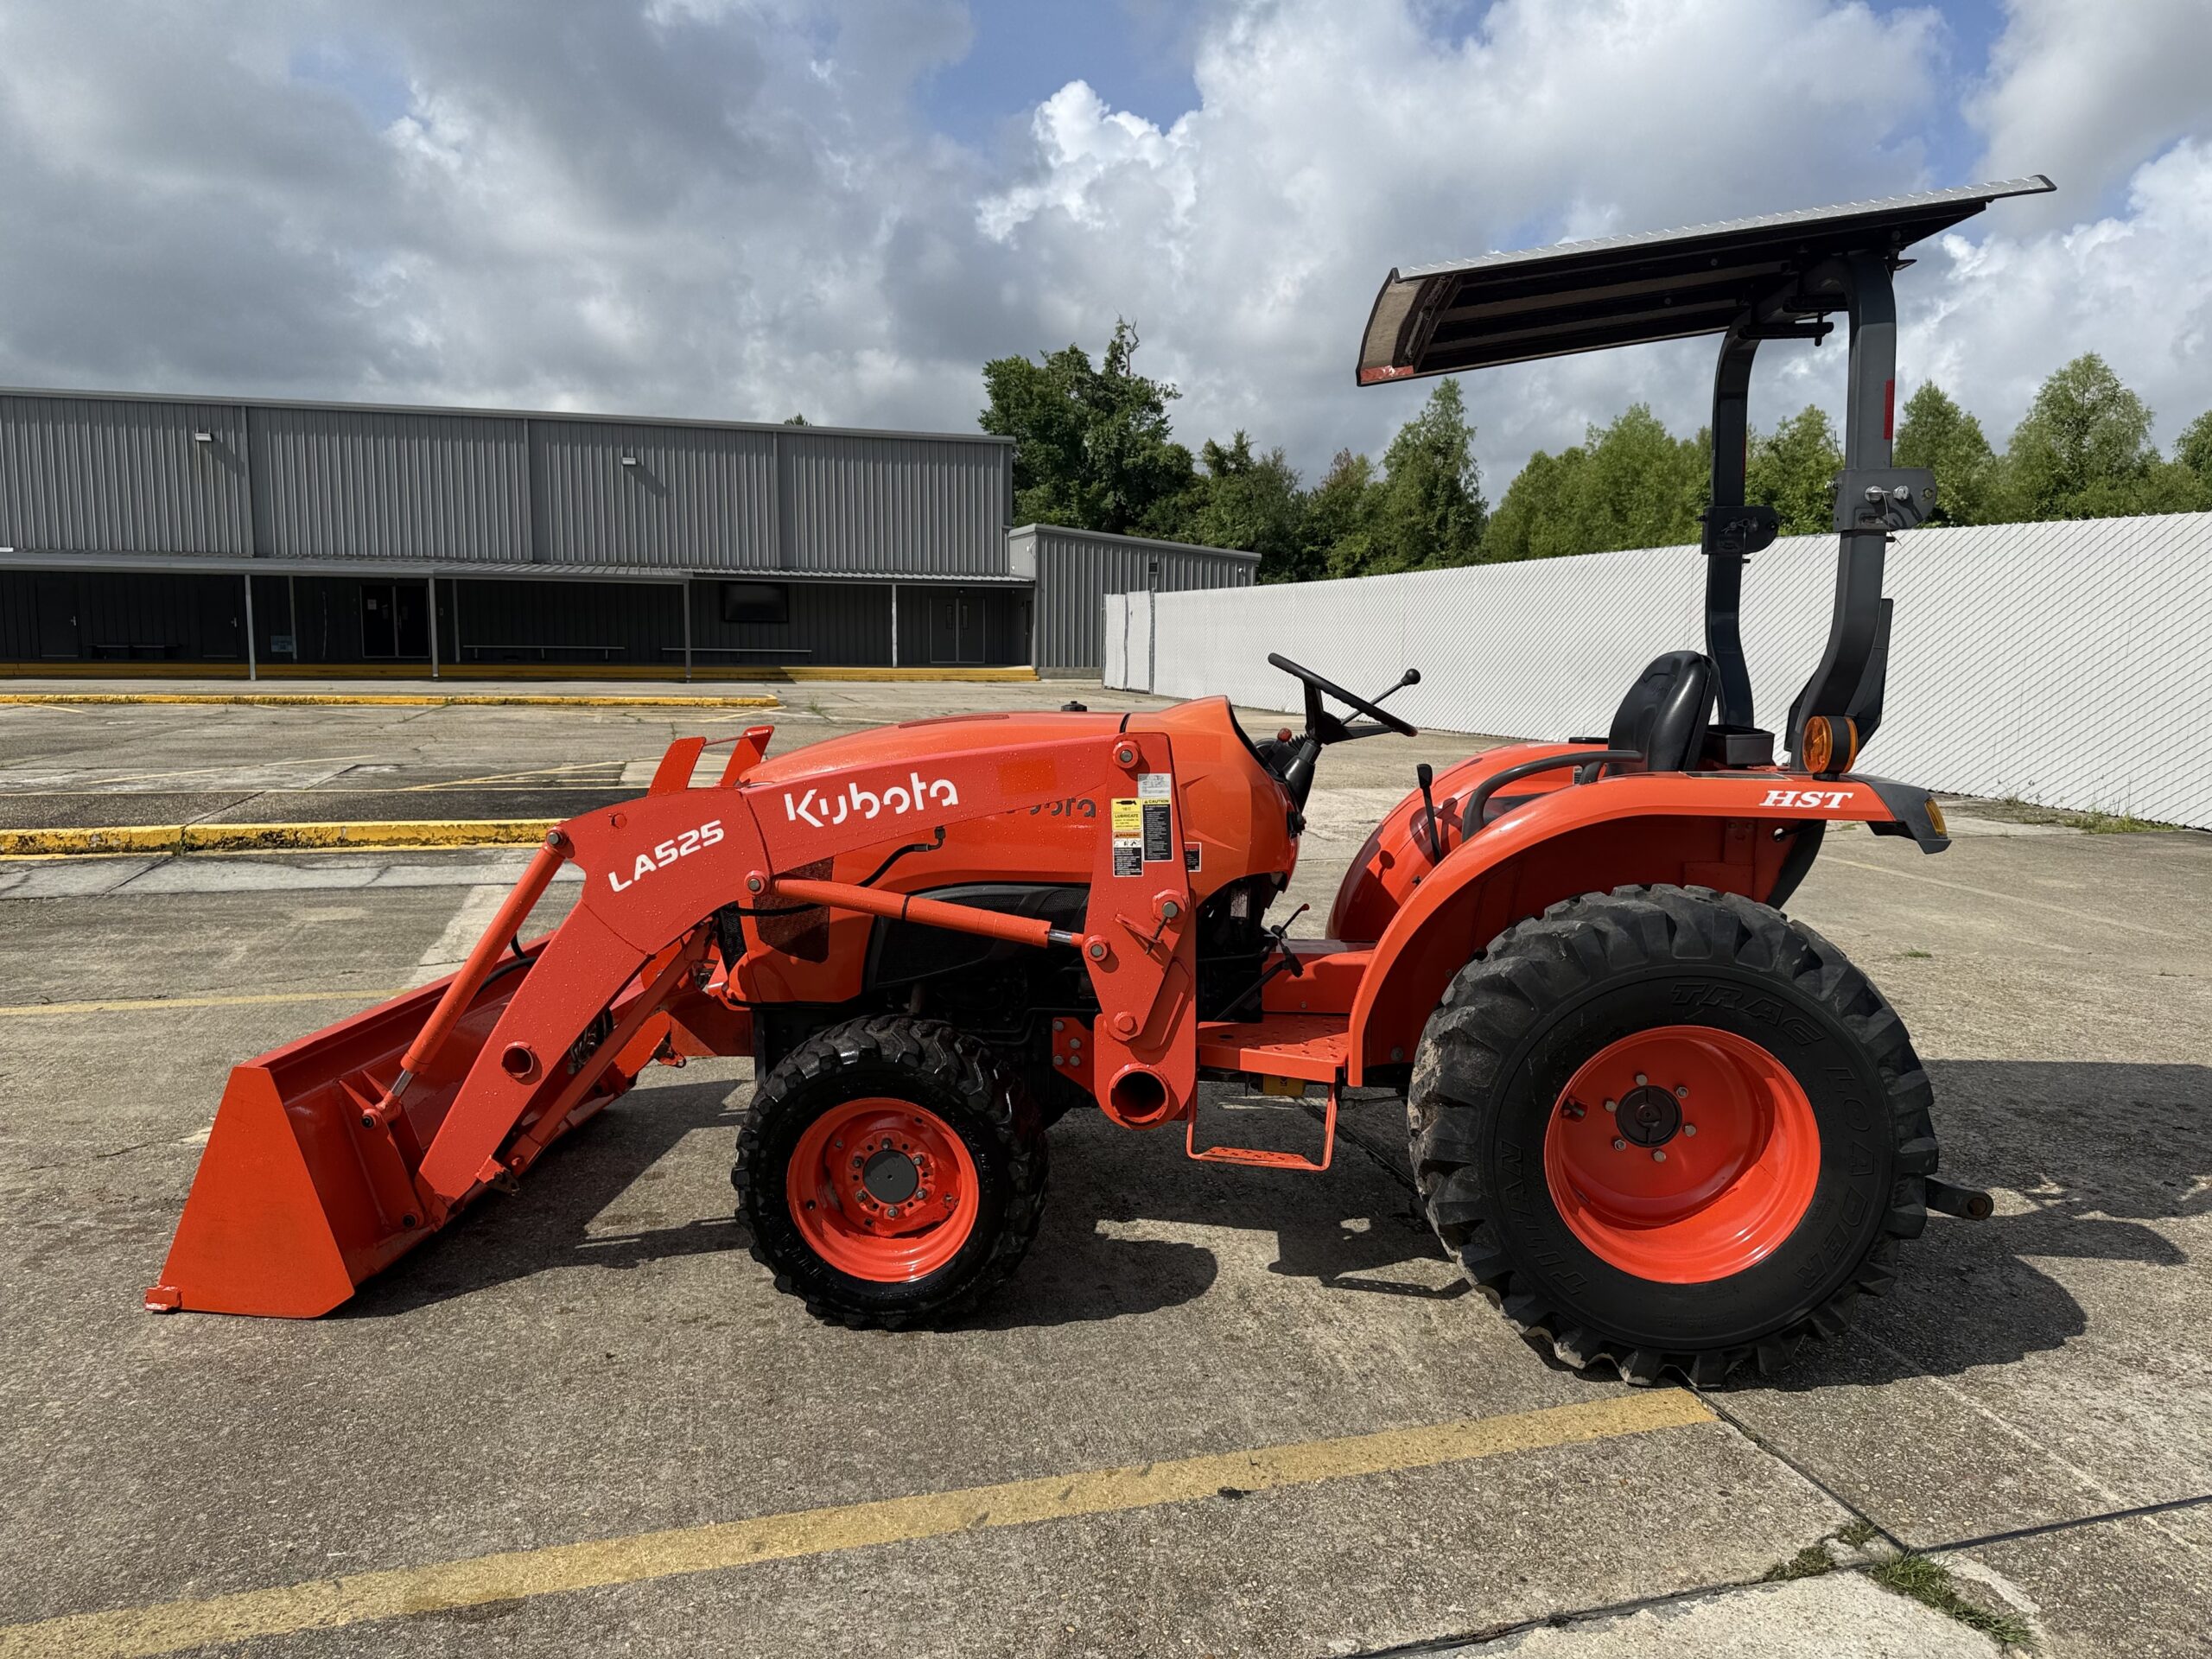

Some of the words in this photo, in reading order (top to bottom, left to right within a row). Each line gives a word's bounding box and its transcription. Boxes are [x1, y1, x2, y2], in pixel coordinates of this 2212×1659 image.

[784, 772, 959, 828] Kubota
[1759, 790, 1853, 809] HST
[608, 819, 724, 893] LA525
[1671, 982, 1825, 1047] TRAC
[1793, 1066, 1875, 1290] LOADER
[1500, 1141, 1588, 1295] TITAN
